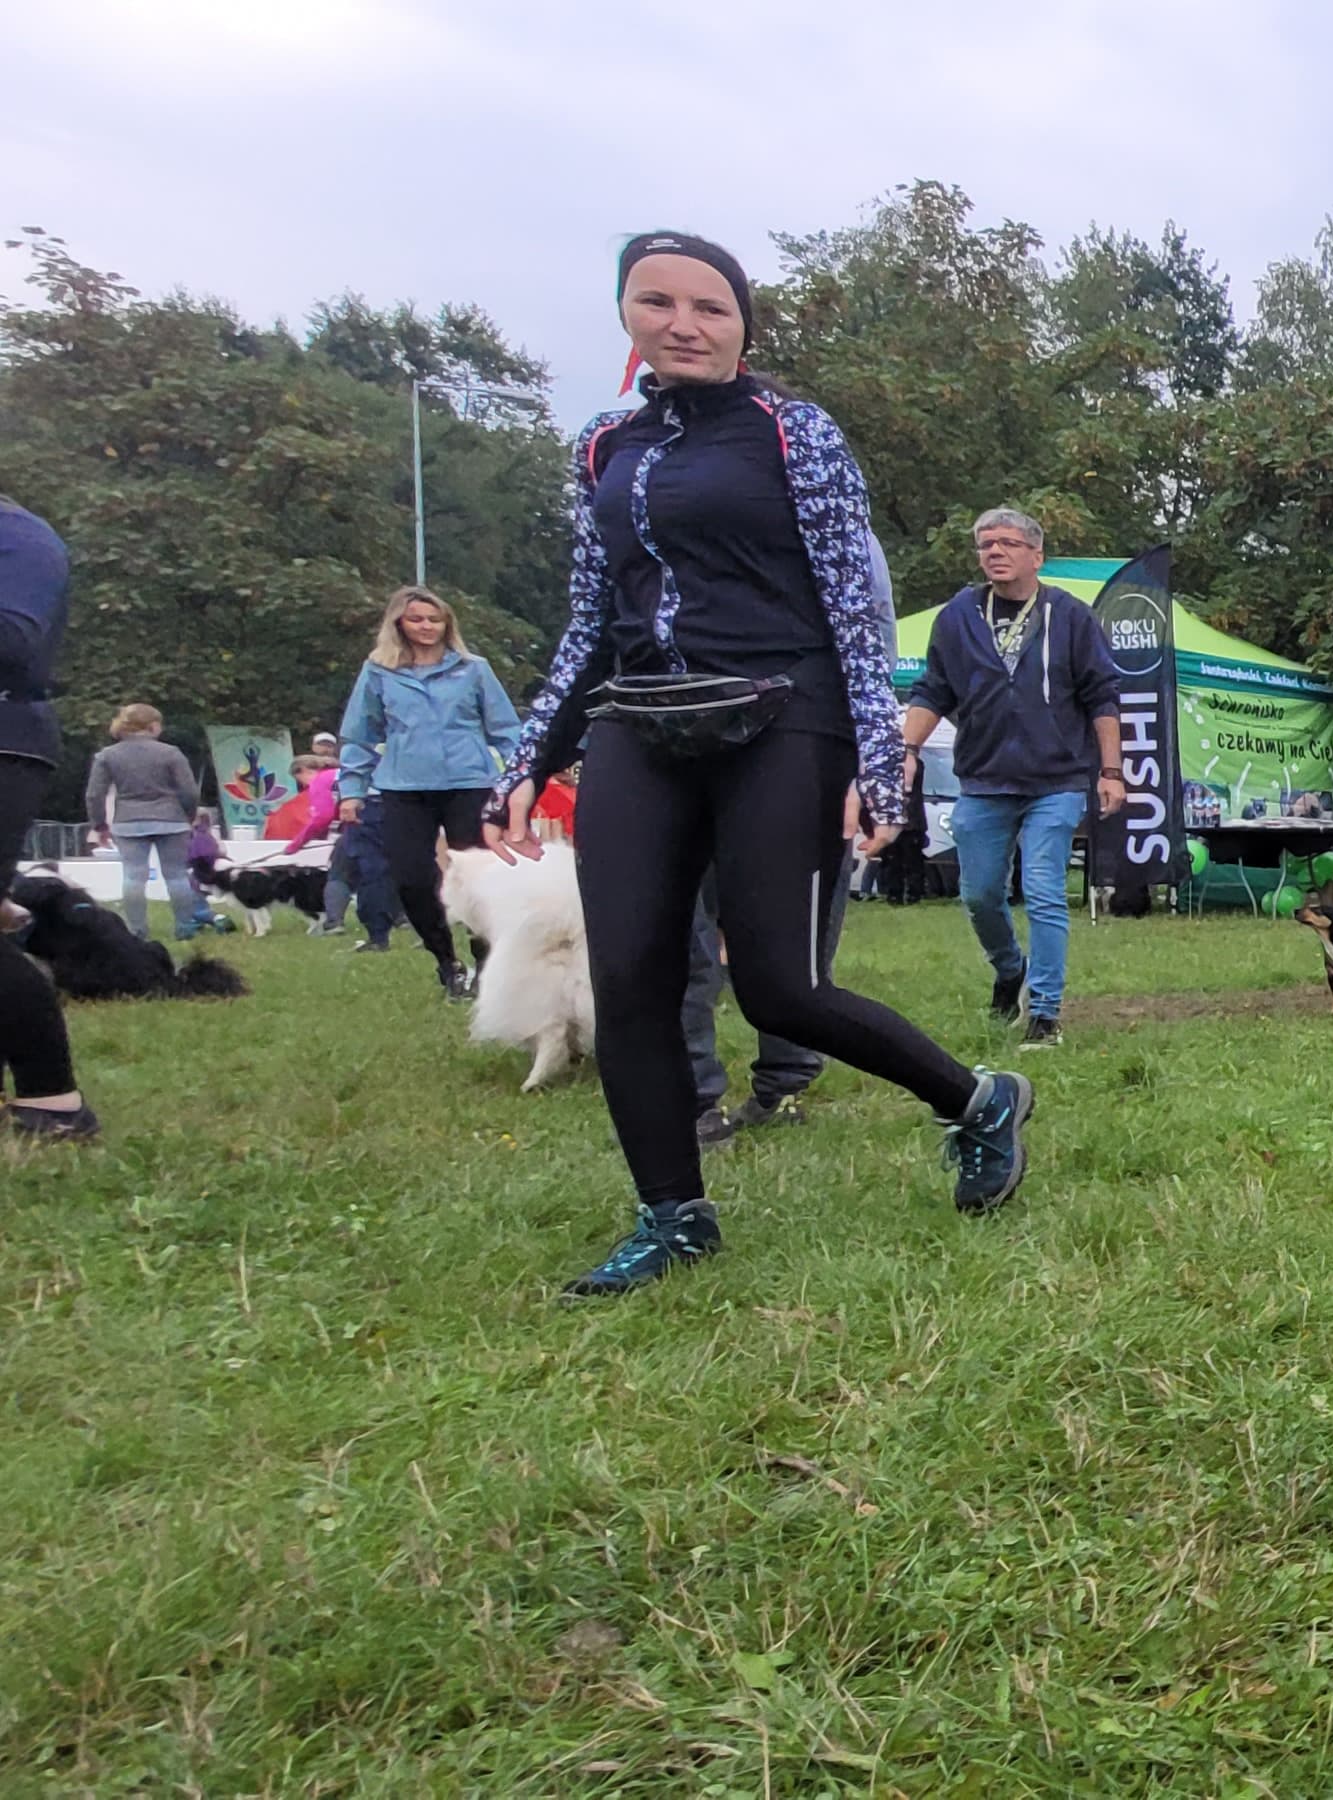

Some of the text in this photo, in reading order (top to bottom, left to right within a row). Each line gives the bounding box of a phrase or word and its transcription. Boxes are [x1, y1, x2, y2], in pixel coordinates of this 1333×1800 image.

[1111, 619, 1156, 635] KOKU
[1111, 633, 1158, 650] SUSHI
[1208, 692, 1285, 720] Schronisko
[1217, 731, 1285, 763] czekamy
[1290, 743, 1306, 759] na
[1120, 693, 1170, 864] SUSHI
